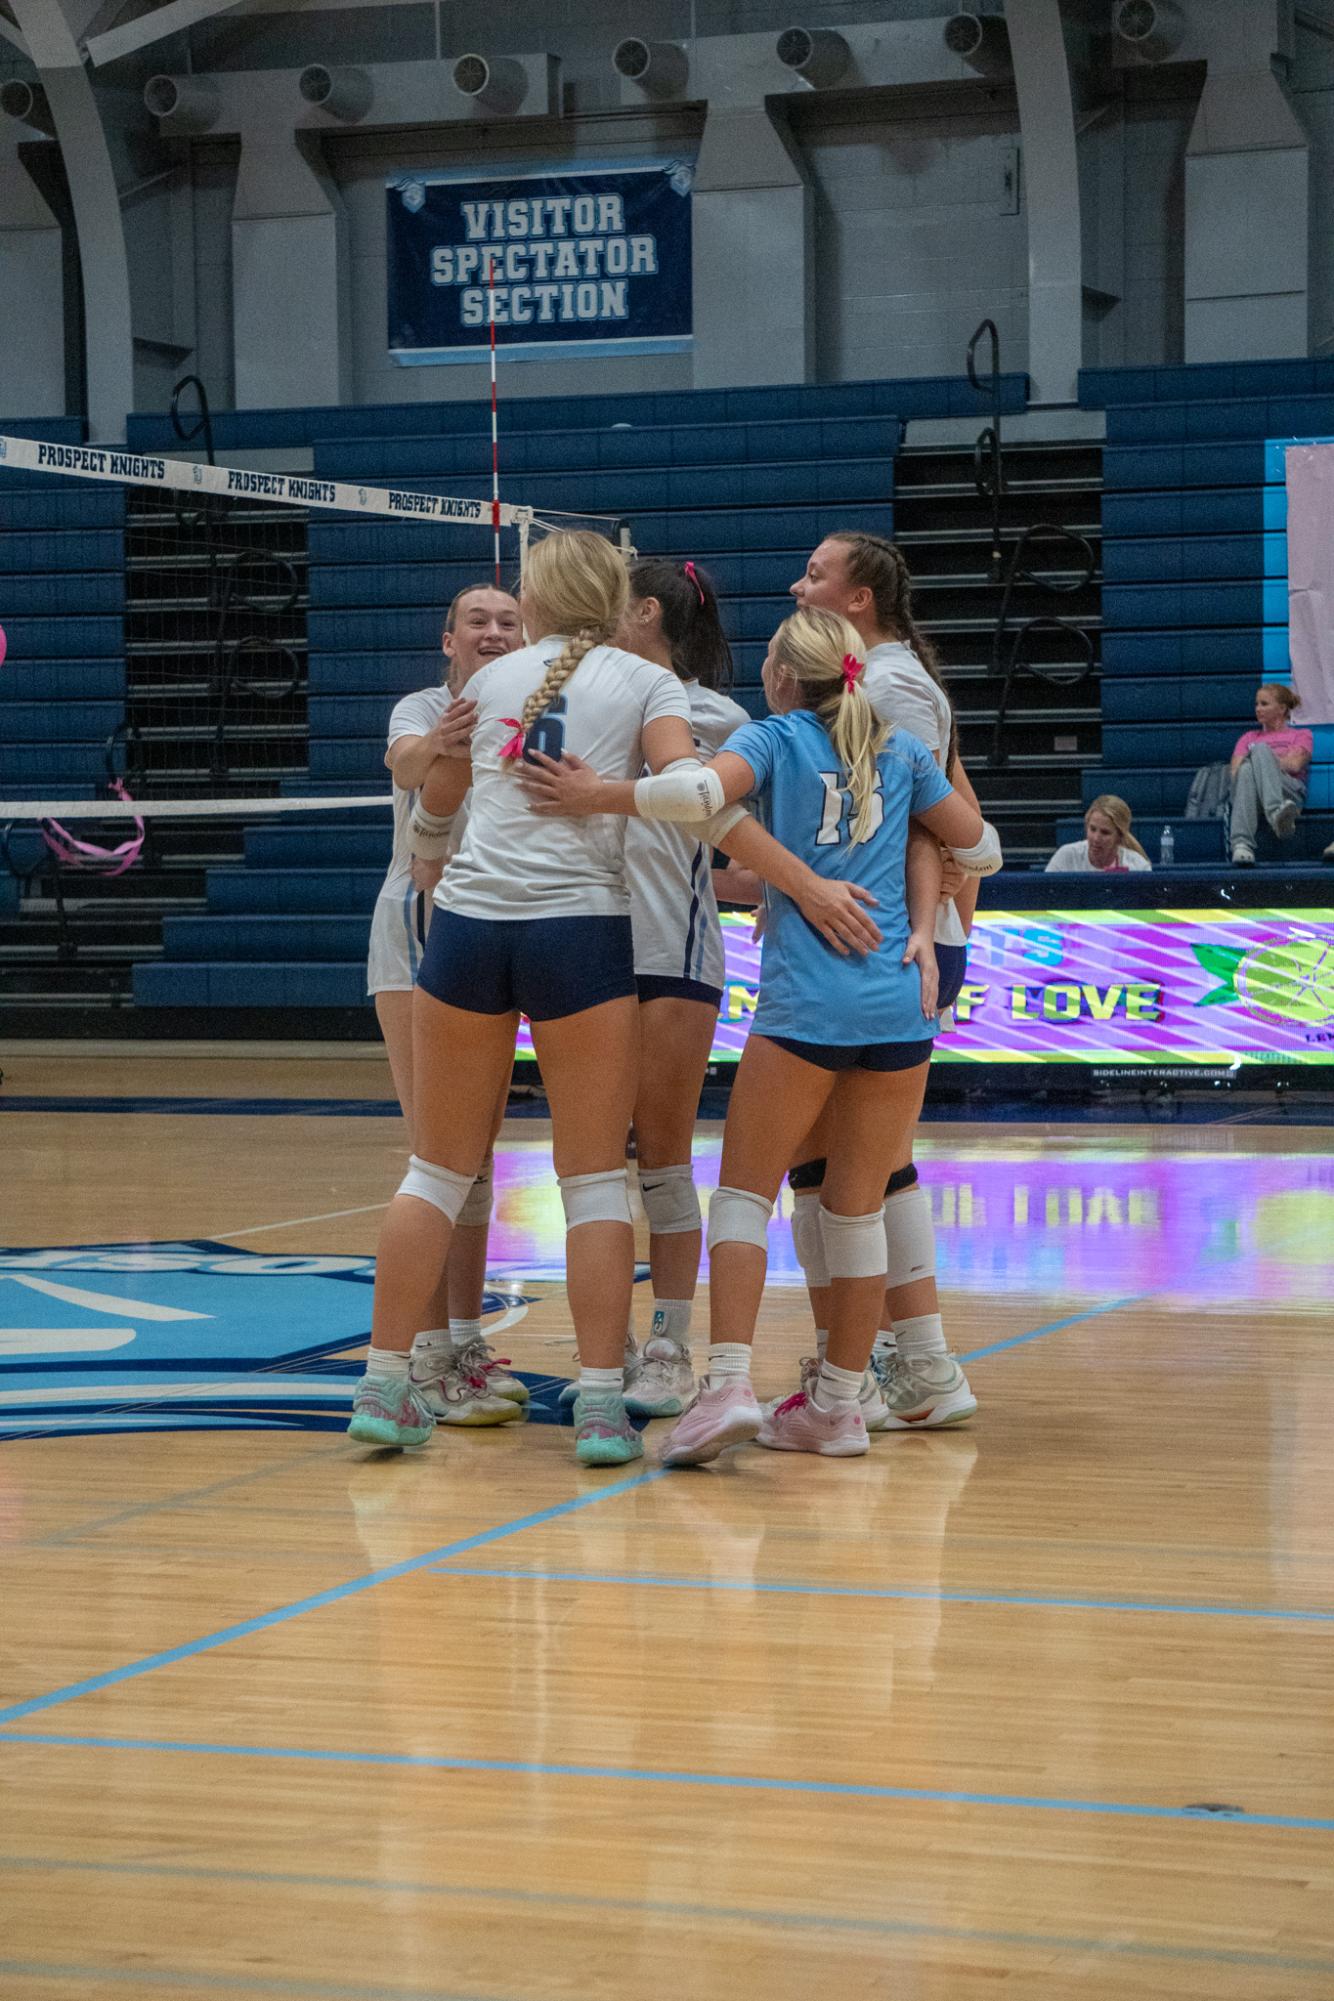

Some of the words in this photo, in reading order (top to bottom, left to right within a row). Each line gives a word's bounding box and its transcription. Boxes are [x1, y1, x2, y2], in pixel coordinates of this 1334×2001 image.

[461, 193, 624, 241] VISITOR
[432, 235, 658, 285] SPECTATOR
[461, 280, 629, 327] SECTION
[38, 444, 107, 472] PROSPECT
[110, 454, 165, 479] KNIGHTS
[227, 470, 286, 496] PROSPECT
[289, 480, 336, 502] KNIGHTS
[389, 491, 439, 514] PROSPECT
[440, 499, 482, 518] KNIGHTS
[521, 692, 568, 766] 6
[956, 983, 990, 1020] F
[1011, 983, 1161, 1020] LOVE
[1093, 1069, 1225, 1077] SIDELINEINTERACTIVE.COM
